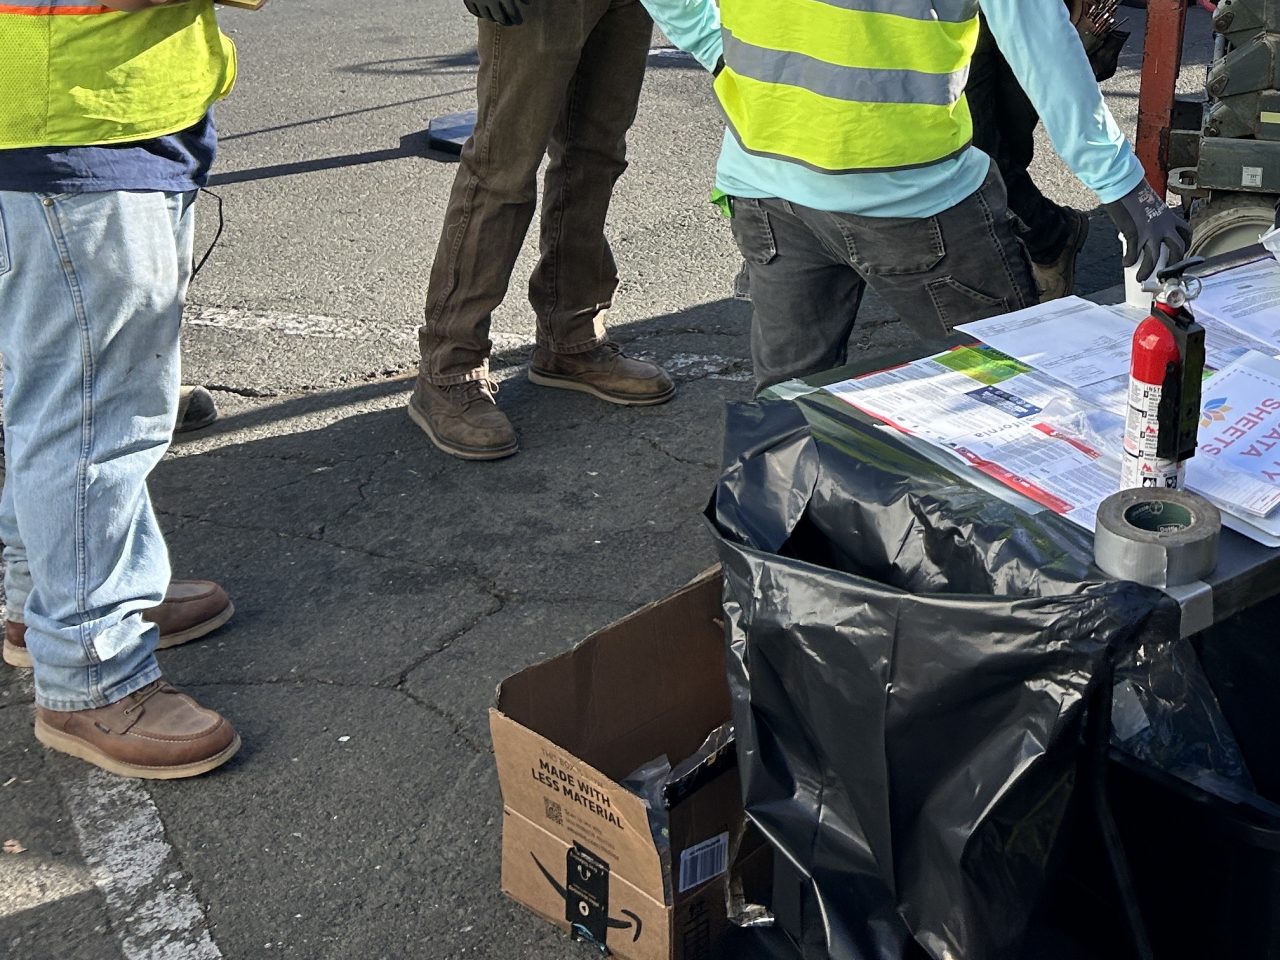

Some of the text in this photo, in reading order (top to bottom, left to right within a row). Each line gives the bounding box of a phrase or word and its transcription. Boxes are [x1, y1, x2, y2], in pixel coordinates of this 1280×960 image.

[531, 767, 560, 792] LESS
[563, 785, 625, 830] MATERIAL
[539, 758, 575, 787] MADE
[577, 782, 611, 808] WITH
